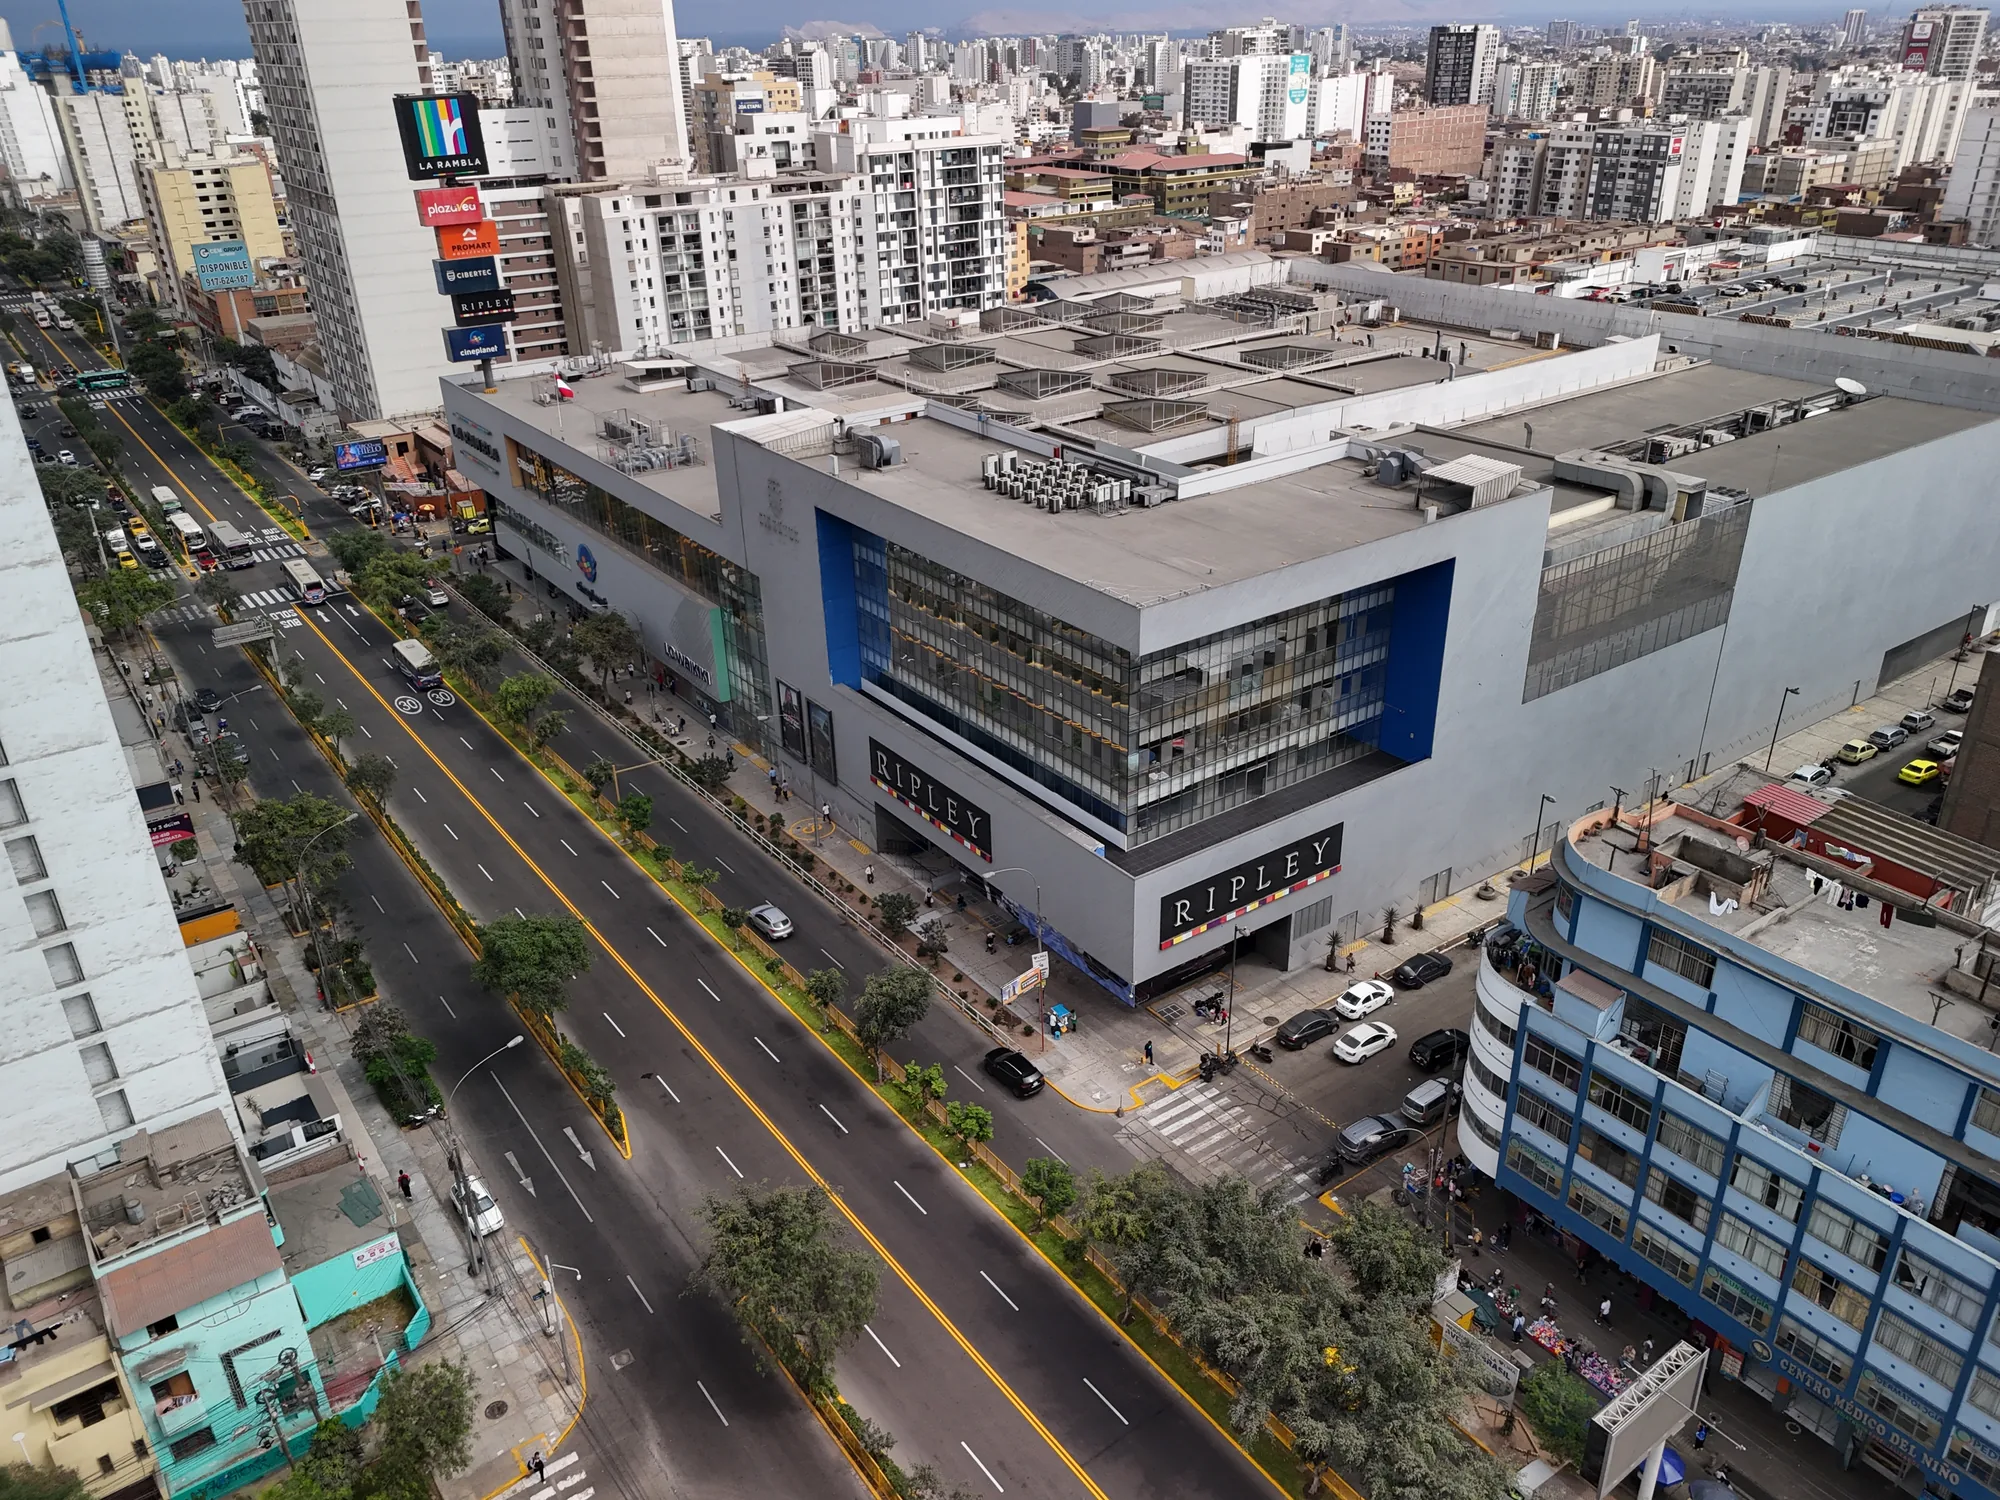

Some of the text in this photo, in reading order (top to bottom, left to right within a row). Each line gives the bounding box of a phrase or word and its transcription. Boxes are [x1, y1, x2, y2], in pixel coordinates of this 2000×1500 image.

[419, 157, 482, 171] LA RAMBLA
[451, 241, 492, 251] PROMART
[200, 260, 248, 273] DISPONIBLE
[456, 268, 492, 279] CIBERTEC
[205, 274, 248, 287] 917-624-187
[461, 298, 510, 312] RIPLEY
[460, 345, 498, 356] cineplanet
[261, 527, 281, 536] BUS
[264, 533, 290, 542] SOLO
[269, 609, 298, 621] SOLO
[280, 618, 303, 629] BUS
[431, 691, 451, 703] 30
[398, 699, 419, 711] 30
[876, 750, 982, 839] RIPLEY
[1173, 836, 1331, 928] RIPLEY
[1779, 1358, 1831, 1399] CENTRO
[1833, 1394, 1886, 1436] MÉDICO
[1888, 1432, 1917, 1458] DEL
[1921, 1452, 1960, 1485] NIÑO
